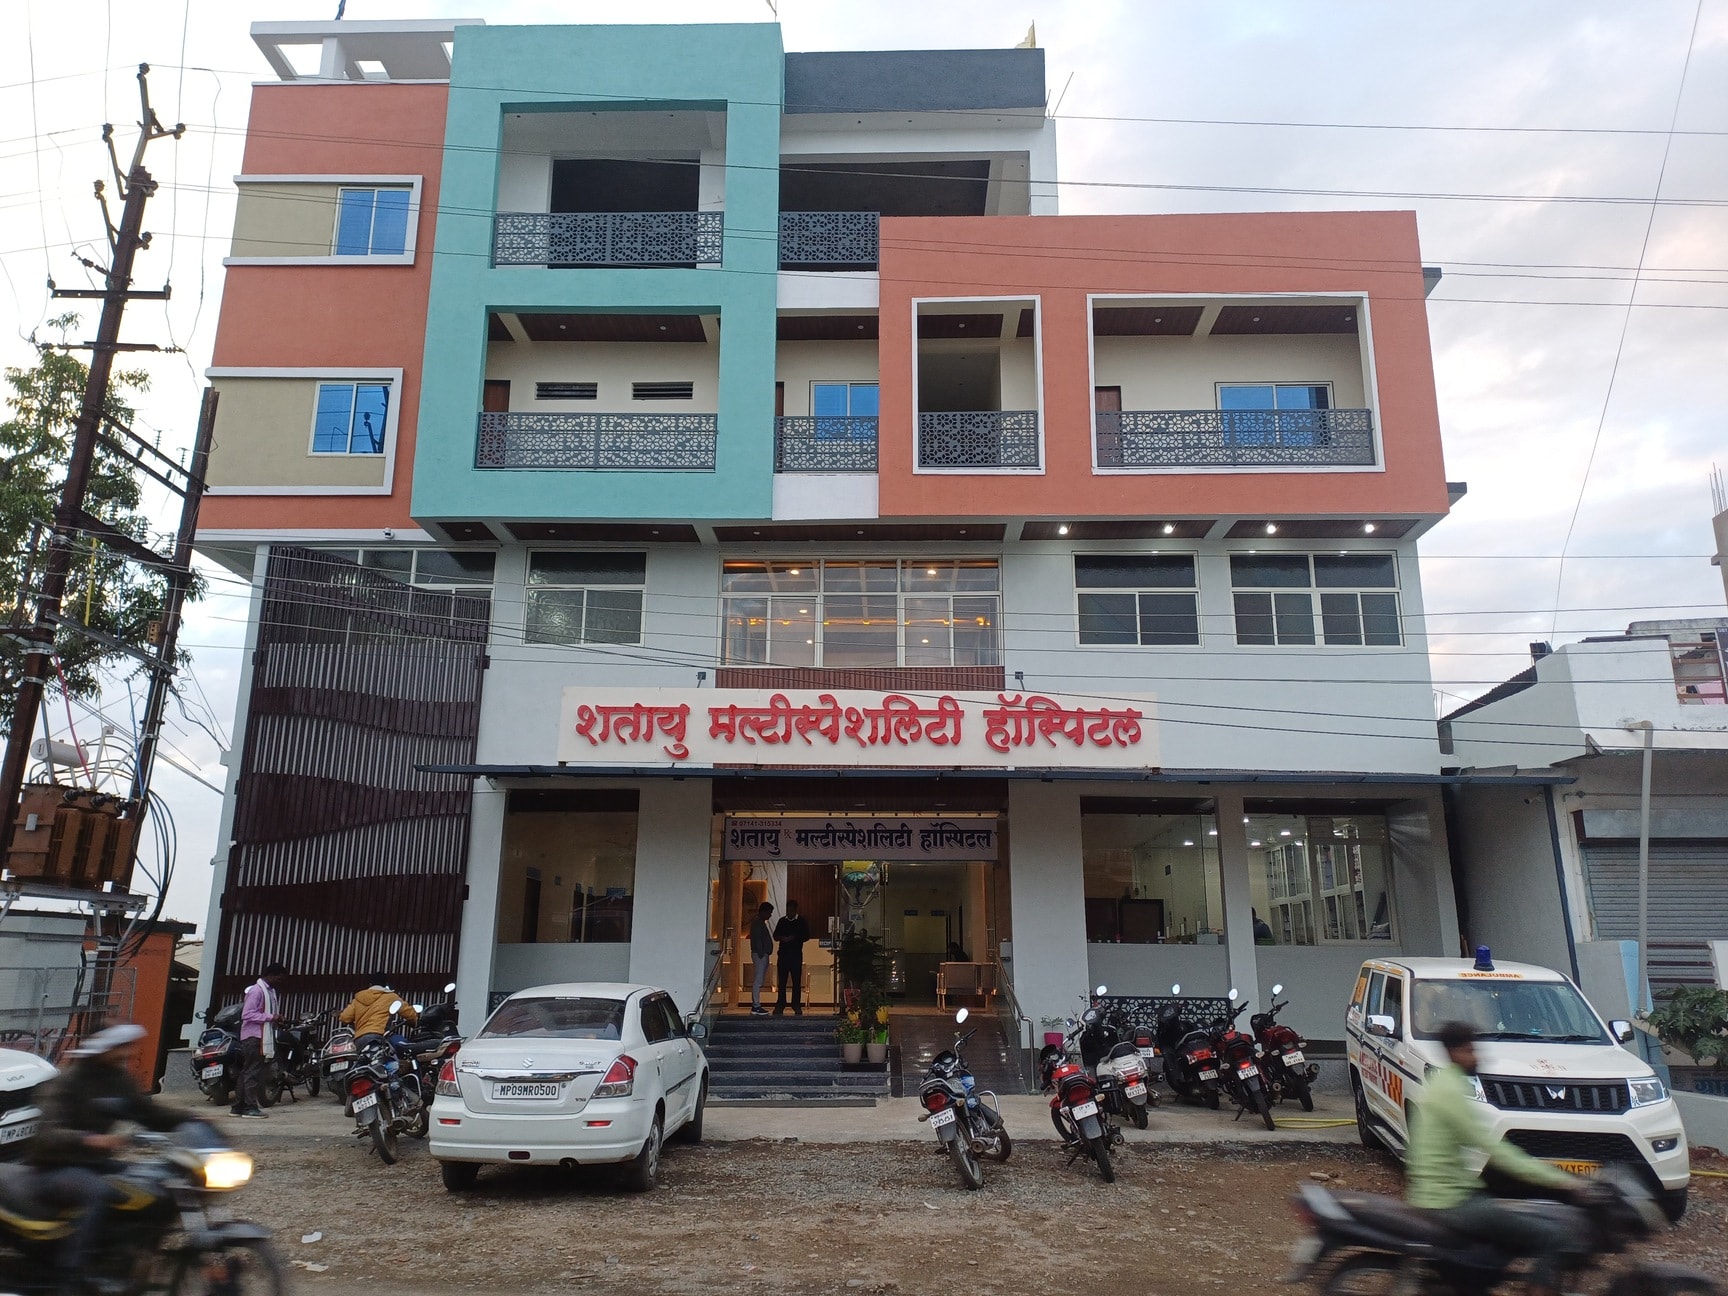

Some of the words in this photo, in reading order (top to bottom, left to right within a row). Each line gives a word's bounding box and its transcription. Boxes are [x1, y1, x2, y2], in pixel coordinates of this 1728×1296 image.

[576, 703, 690, 759] शतायु
[708, 693, 964, 747] मल्टीस्पेशलिटी
[982, 693, 1143, 754] हॉस्पिटल
[730, 828, 781, 855] शतायु
[795, 822, 913, 849] मल्टीस्पेशलिटी
[919, 822, 993, 853] हॉस्पिटल
[499, 1085, 557, 1096] MP09MR0500
